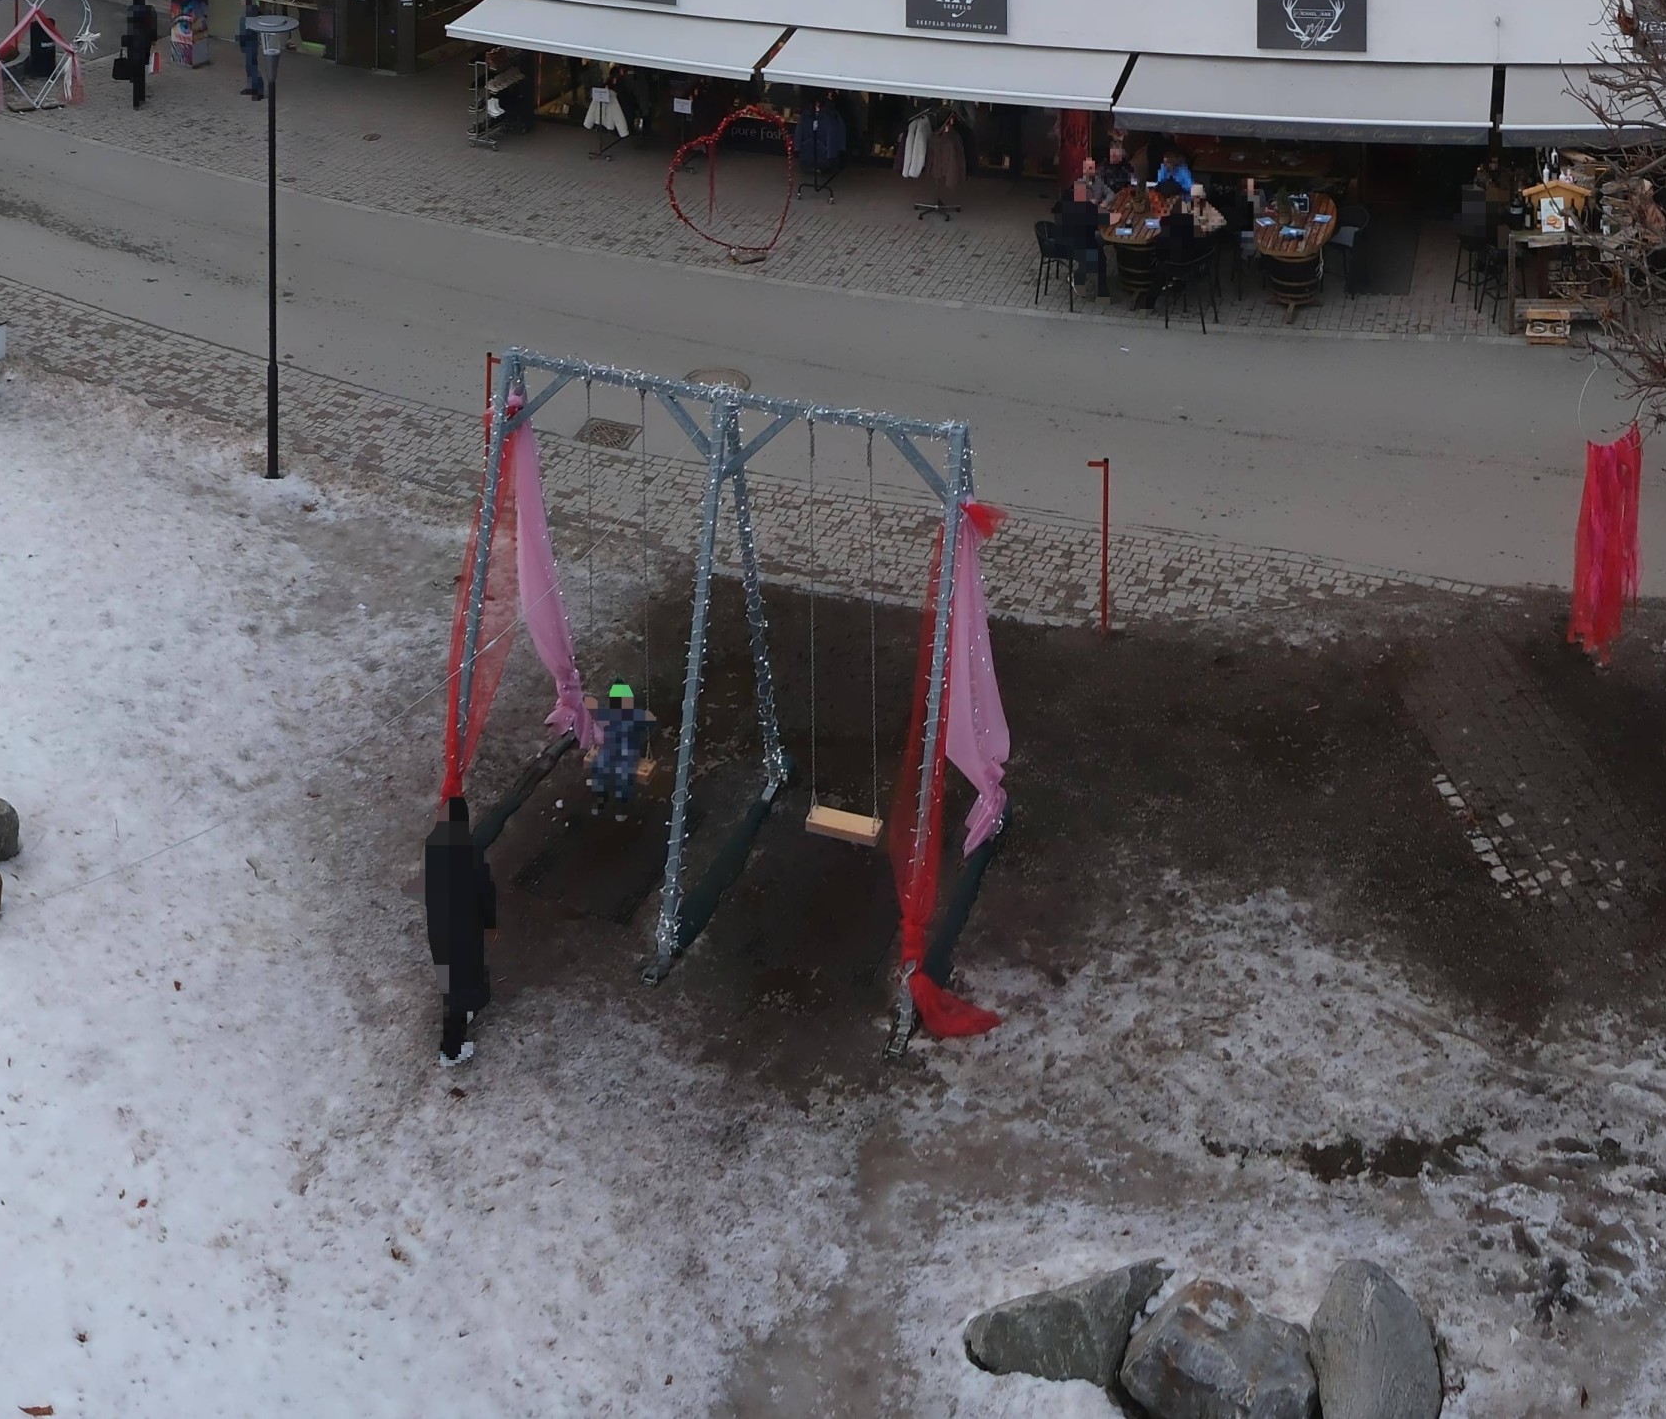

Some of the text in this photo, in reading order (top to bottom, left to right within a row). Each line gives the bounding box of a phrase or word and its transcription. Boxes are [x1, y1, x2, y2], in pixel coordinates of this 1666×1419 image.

[943, 3, 972, 11] SEEFELD
[916, 19, 944, 27] SEEFELD
[947, 21, 982, 30] SHOPPING
